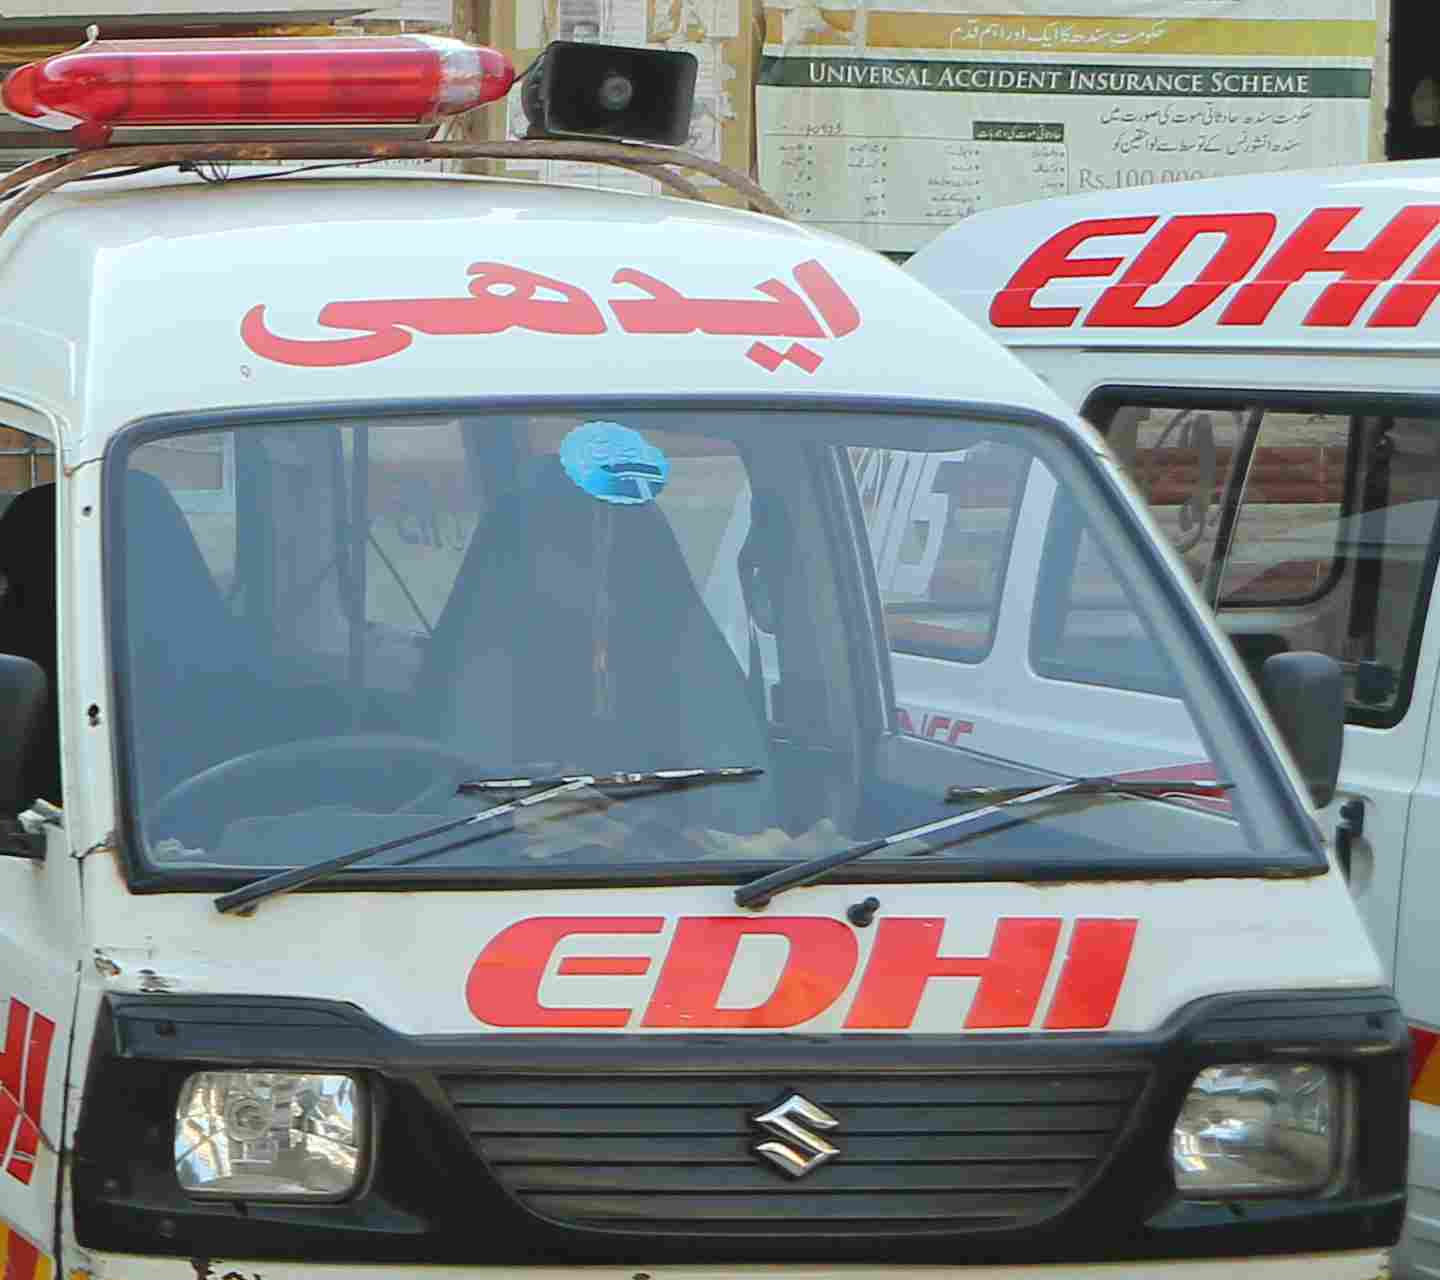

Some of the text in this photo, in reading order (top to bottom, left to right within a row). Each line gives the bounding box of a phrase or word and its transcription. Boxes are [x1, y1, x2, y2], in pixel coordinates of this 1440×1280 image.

[808, 62, 1310, 95] UNIVERSAL ACCIDENT INSURANCE SCHEME
[989, 204, 1440, 328] EDHI
[465, 916, 1139, 1031] EDHI
